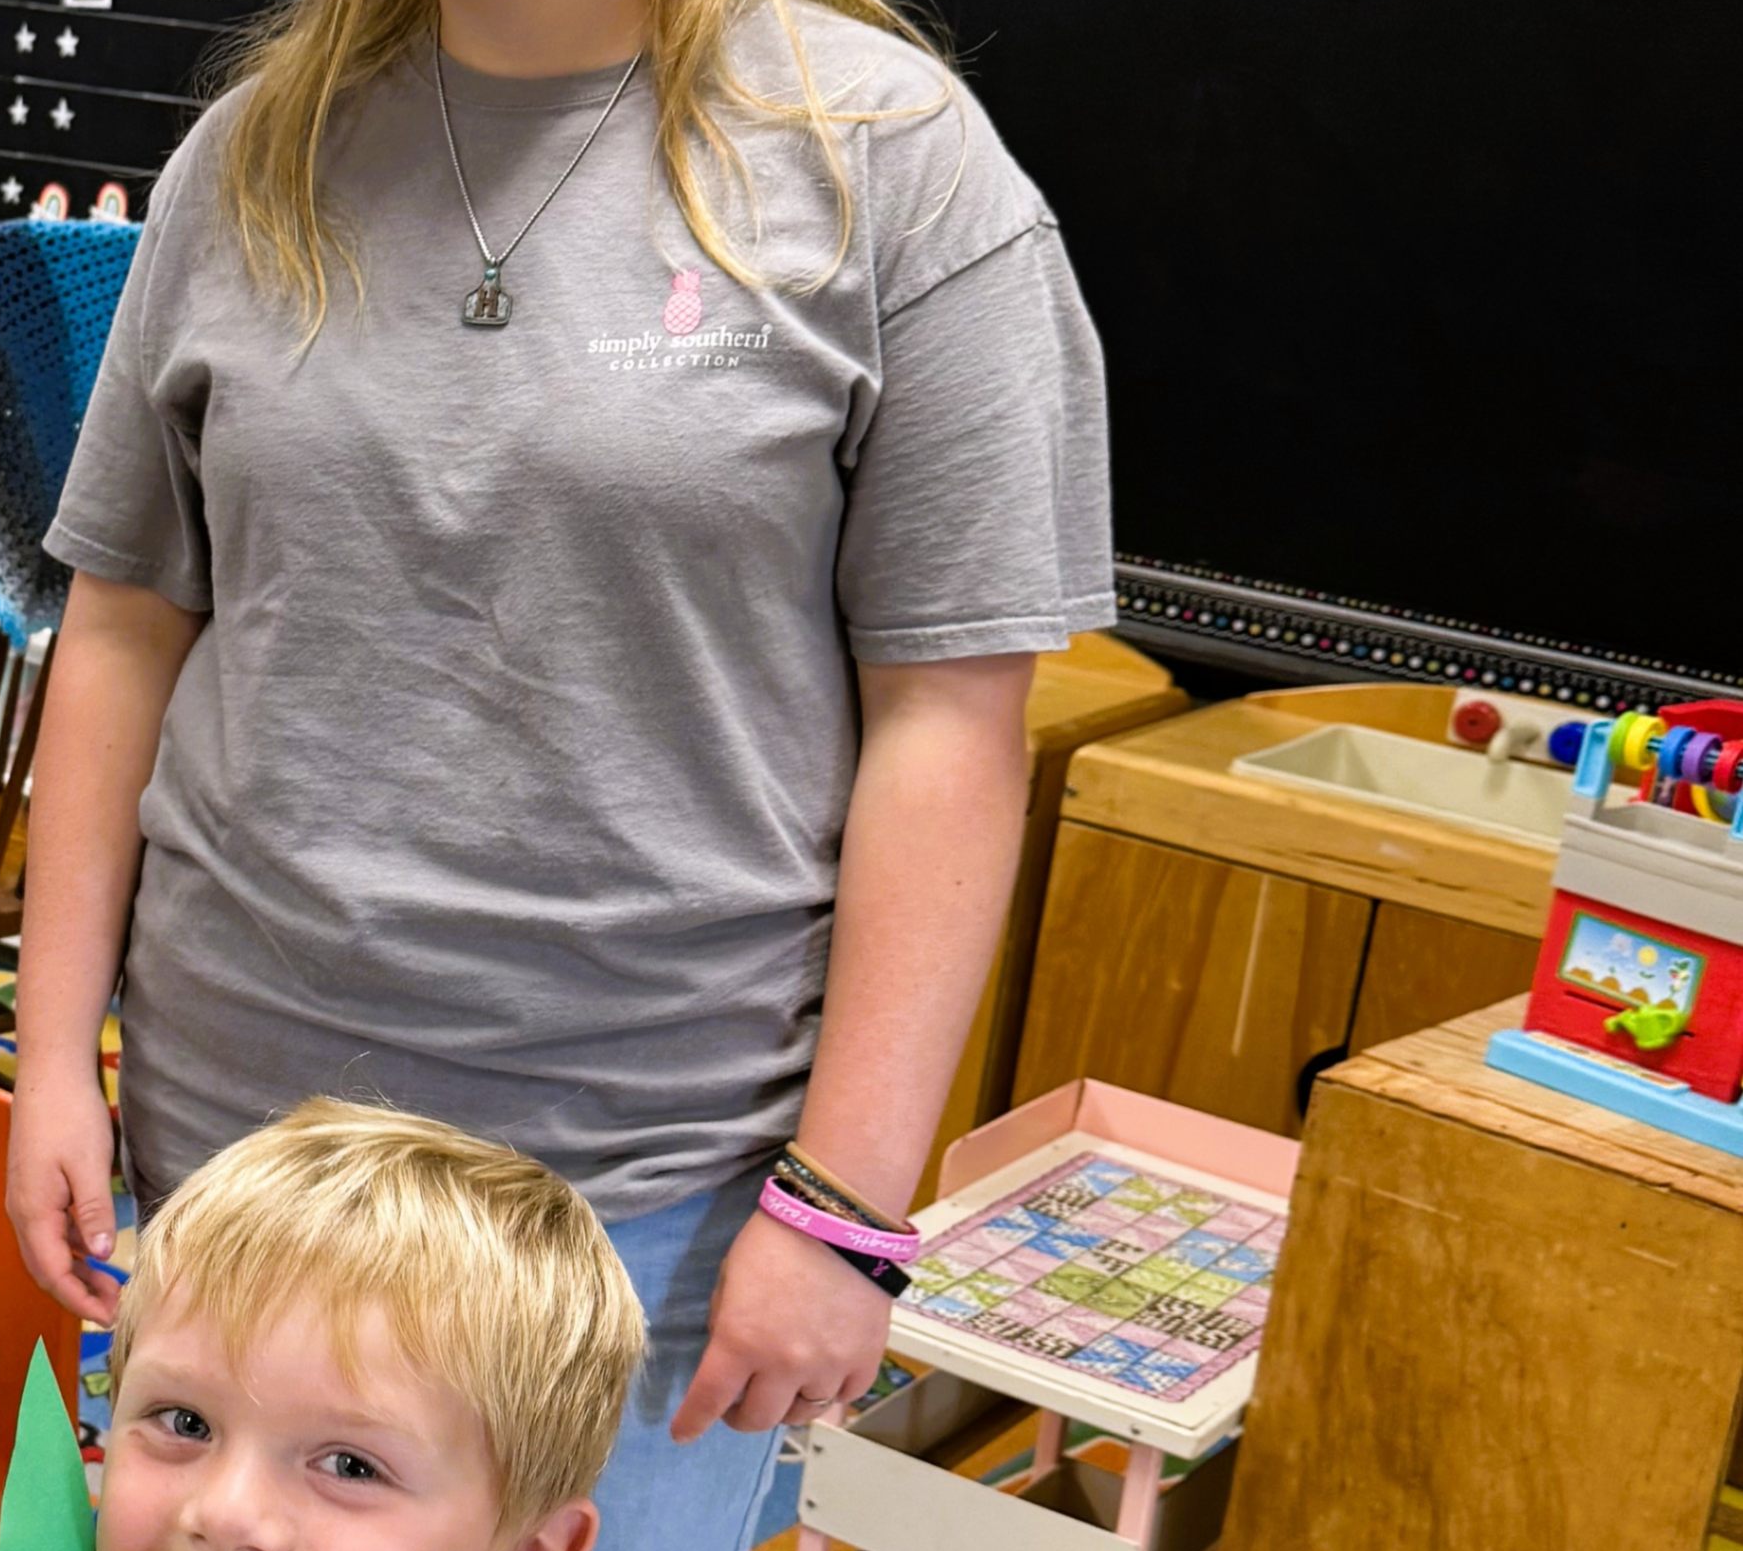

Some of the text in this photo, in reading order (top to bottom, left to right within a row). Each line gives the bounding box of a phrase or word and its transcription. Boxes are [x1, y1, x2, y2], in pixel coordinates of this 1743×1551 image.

[587, 324, 770, 356] simply southern
[609, 353, 740, 371] COLLECTION
